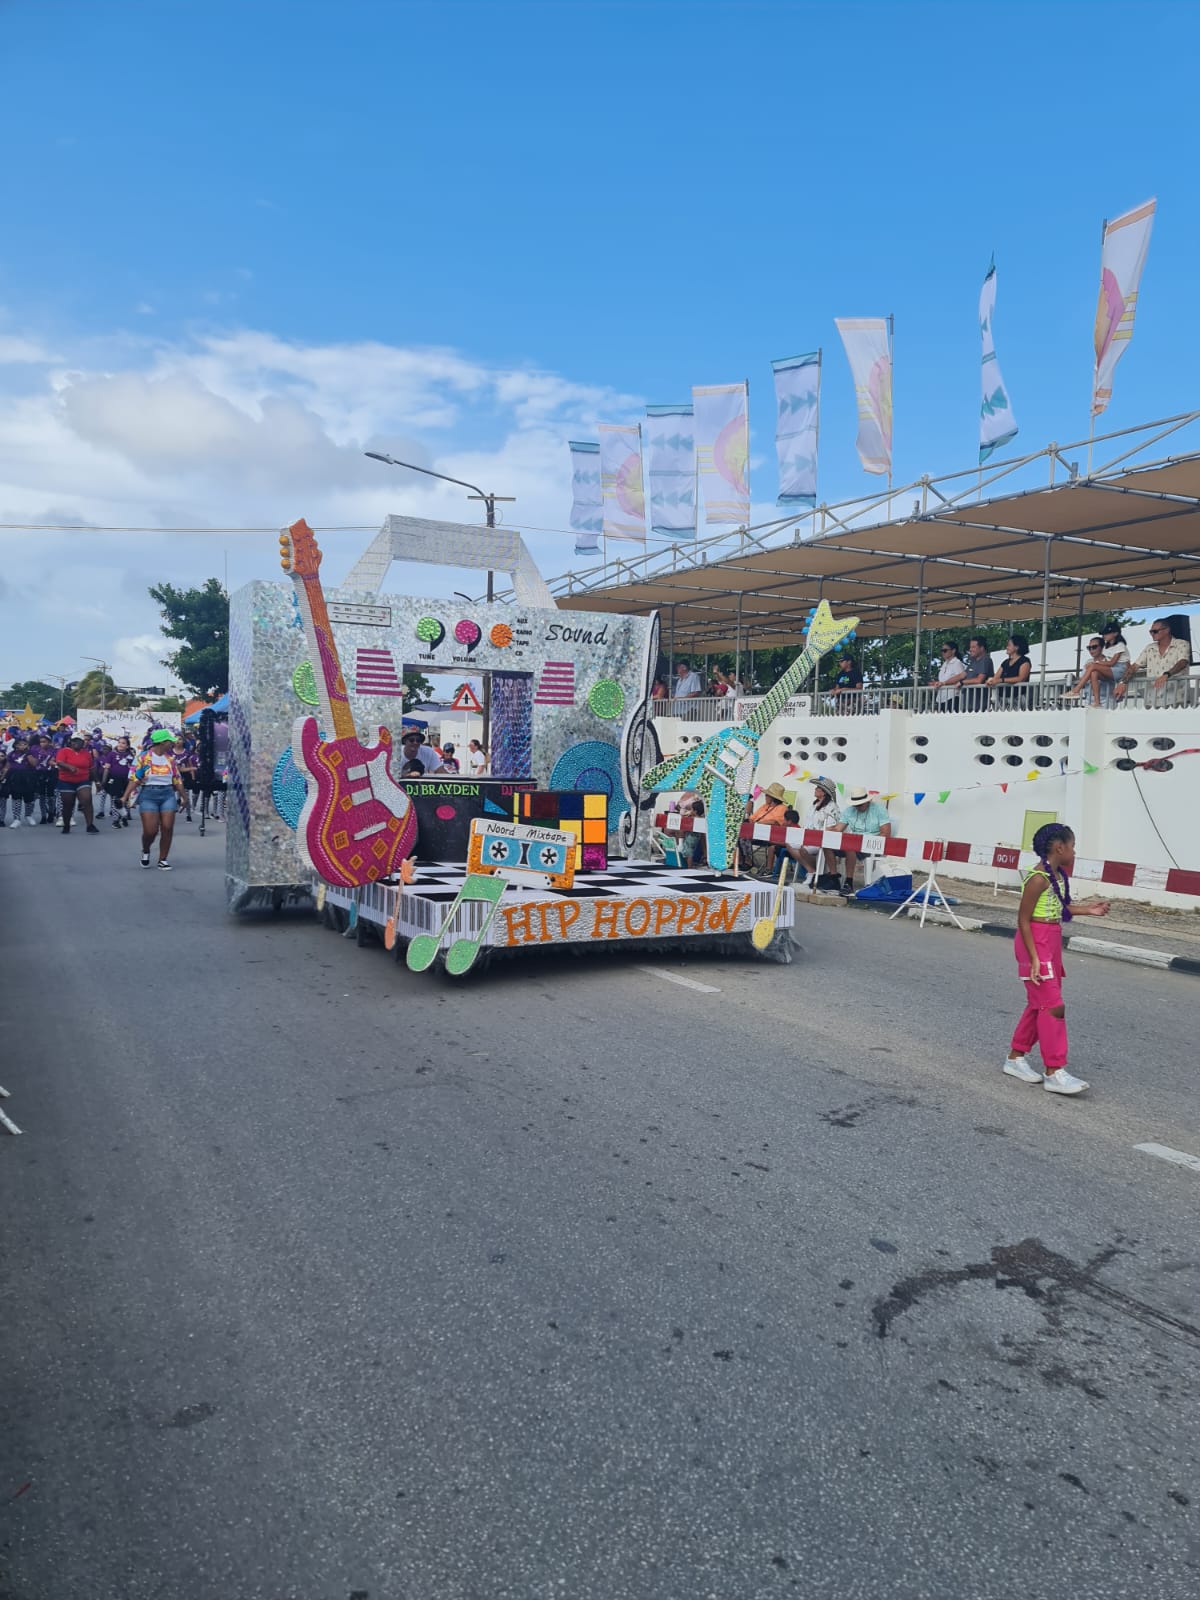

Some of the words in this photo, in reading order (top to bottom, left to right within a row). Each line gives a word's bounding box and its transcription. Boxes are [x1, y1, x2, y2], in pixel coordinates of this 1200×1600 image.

[545, 623, 608, 646] Sound
[406, 784, 419, 796] DJ
[421, 784, 479, 796] BRAYDEN
[486, 823, 516, 836] Noord
[526, 829, 567, 842] Mixtape
[502, 899, 580, 946] HIP
